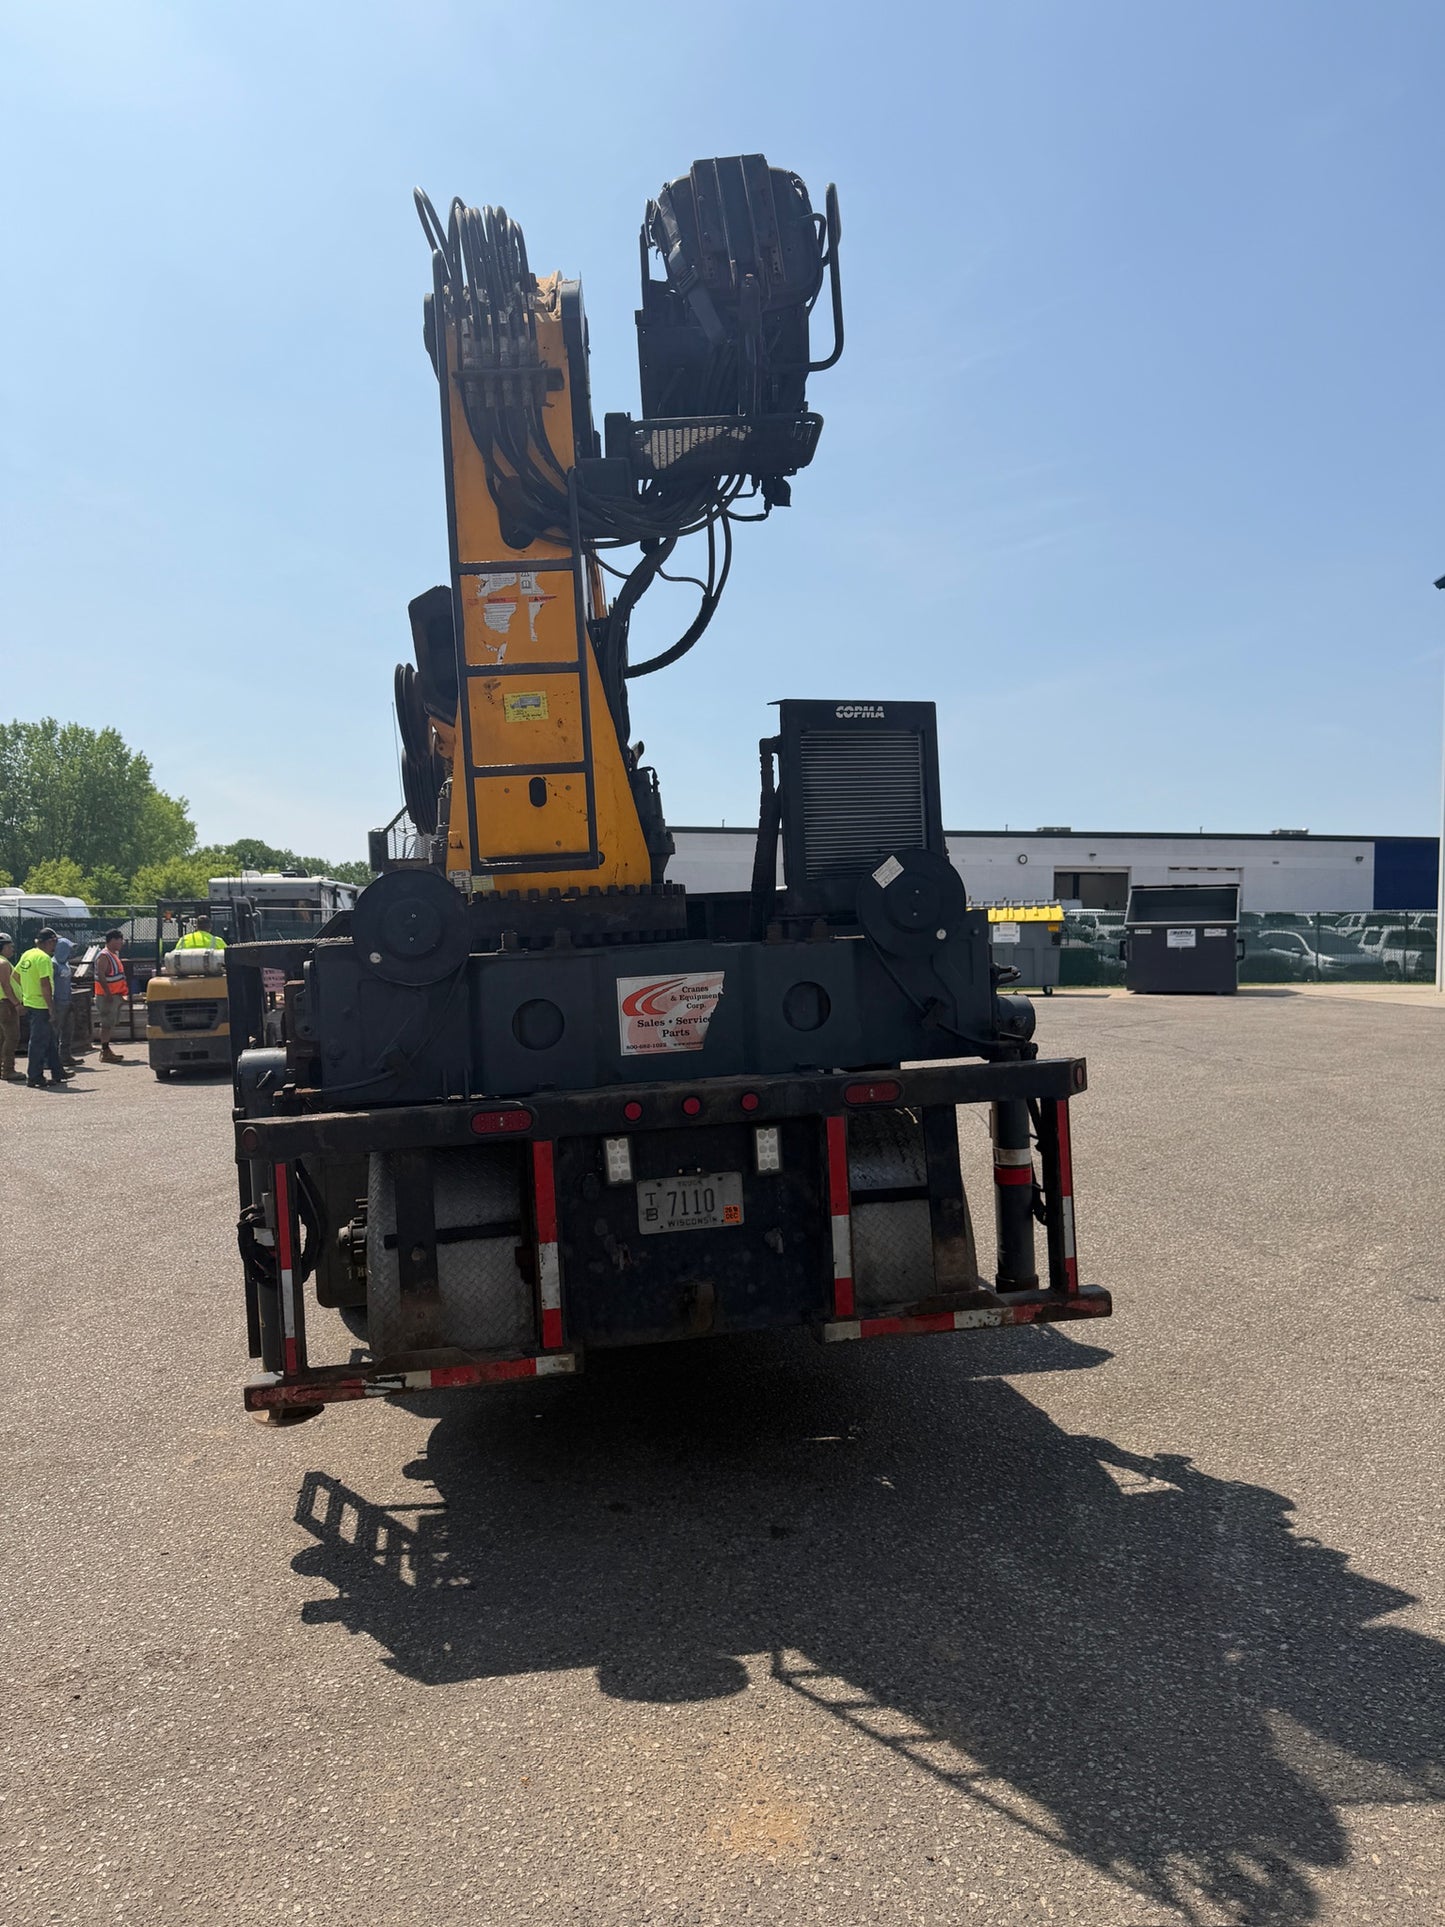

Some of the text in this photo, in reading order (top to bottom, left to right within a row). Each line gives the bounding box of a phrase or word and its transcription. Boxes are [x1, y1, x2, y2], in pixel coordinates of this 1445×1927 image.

[835, 705, 885, 718] COPMA
[679, 993, 719, 1001] Equipmen
[637, 1019, 665, 1028] Sales
[662, 1029, 690, 1037] Parts
[667, 1188, 715, 1217] 7110
[668, 1217, 717, 1228] WISCONSIN
